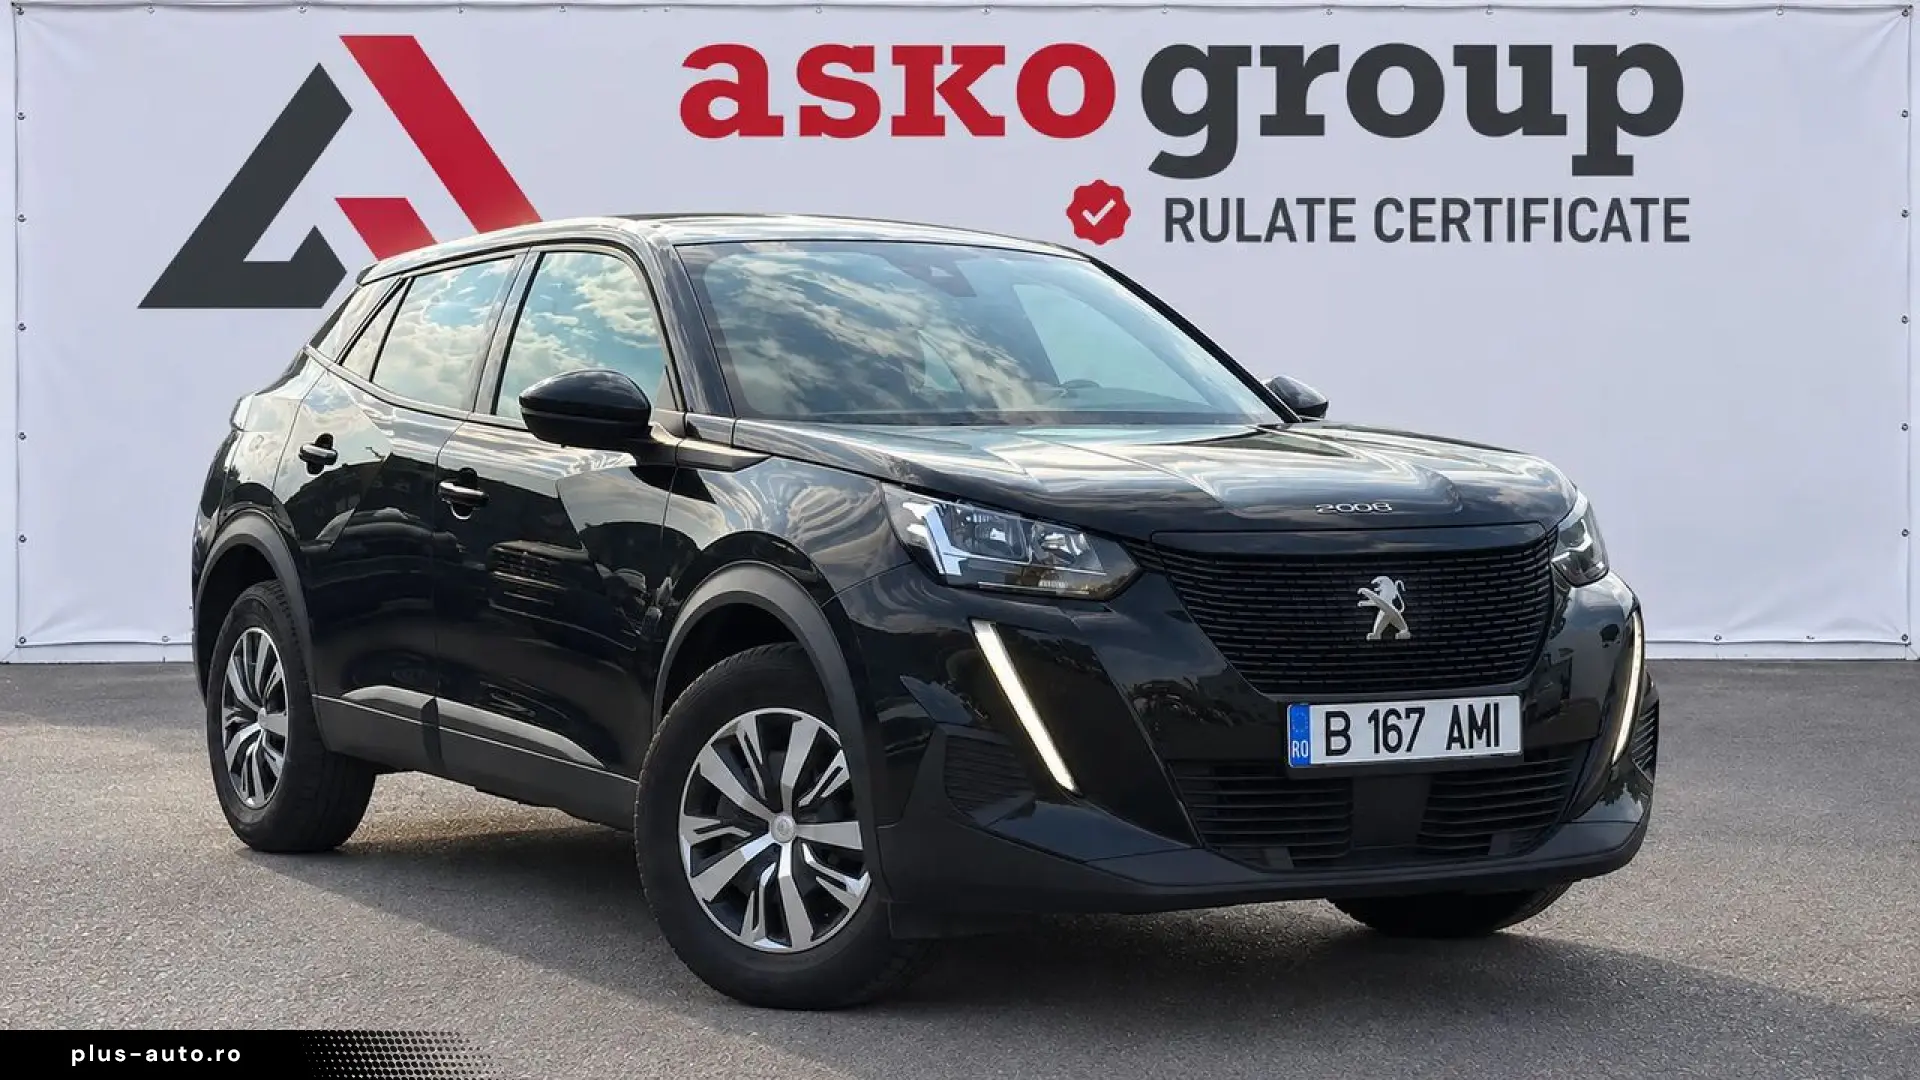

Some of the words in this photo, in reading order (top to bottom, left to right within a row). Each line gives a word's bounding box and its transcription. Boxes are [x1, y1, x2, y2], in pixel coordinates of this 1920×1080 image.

[680, 43, 1116, 138] asko
[1141, 43, 1684, 179] group
[1164, 197, 1357, 243] RULATE
[1373, 197, 1690, 243] CERTIFICATE
[1315, 502, 1393, 514] 2008
[1292, 740, 1309, 758] RO
[1325, 710, 1352, 756] B
[1367, 707, 1426, 754] 167
[1445, 702, 1500, 751] AMI
